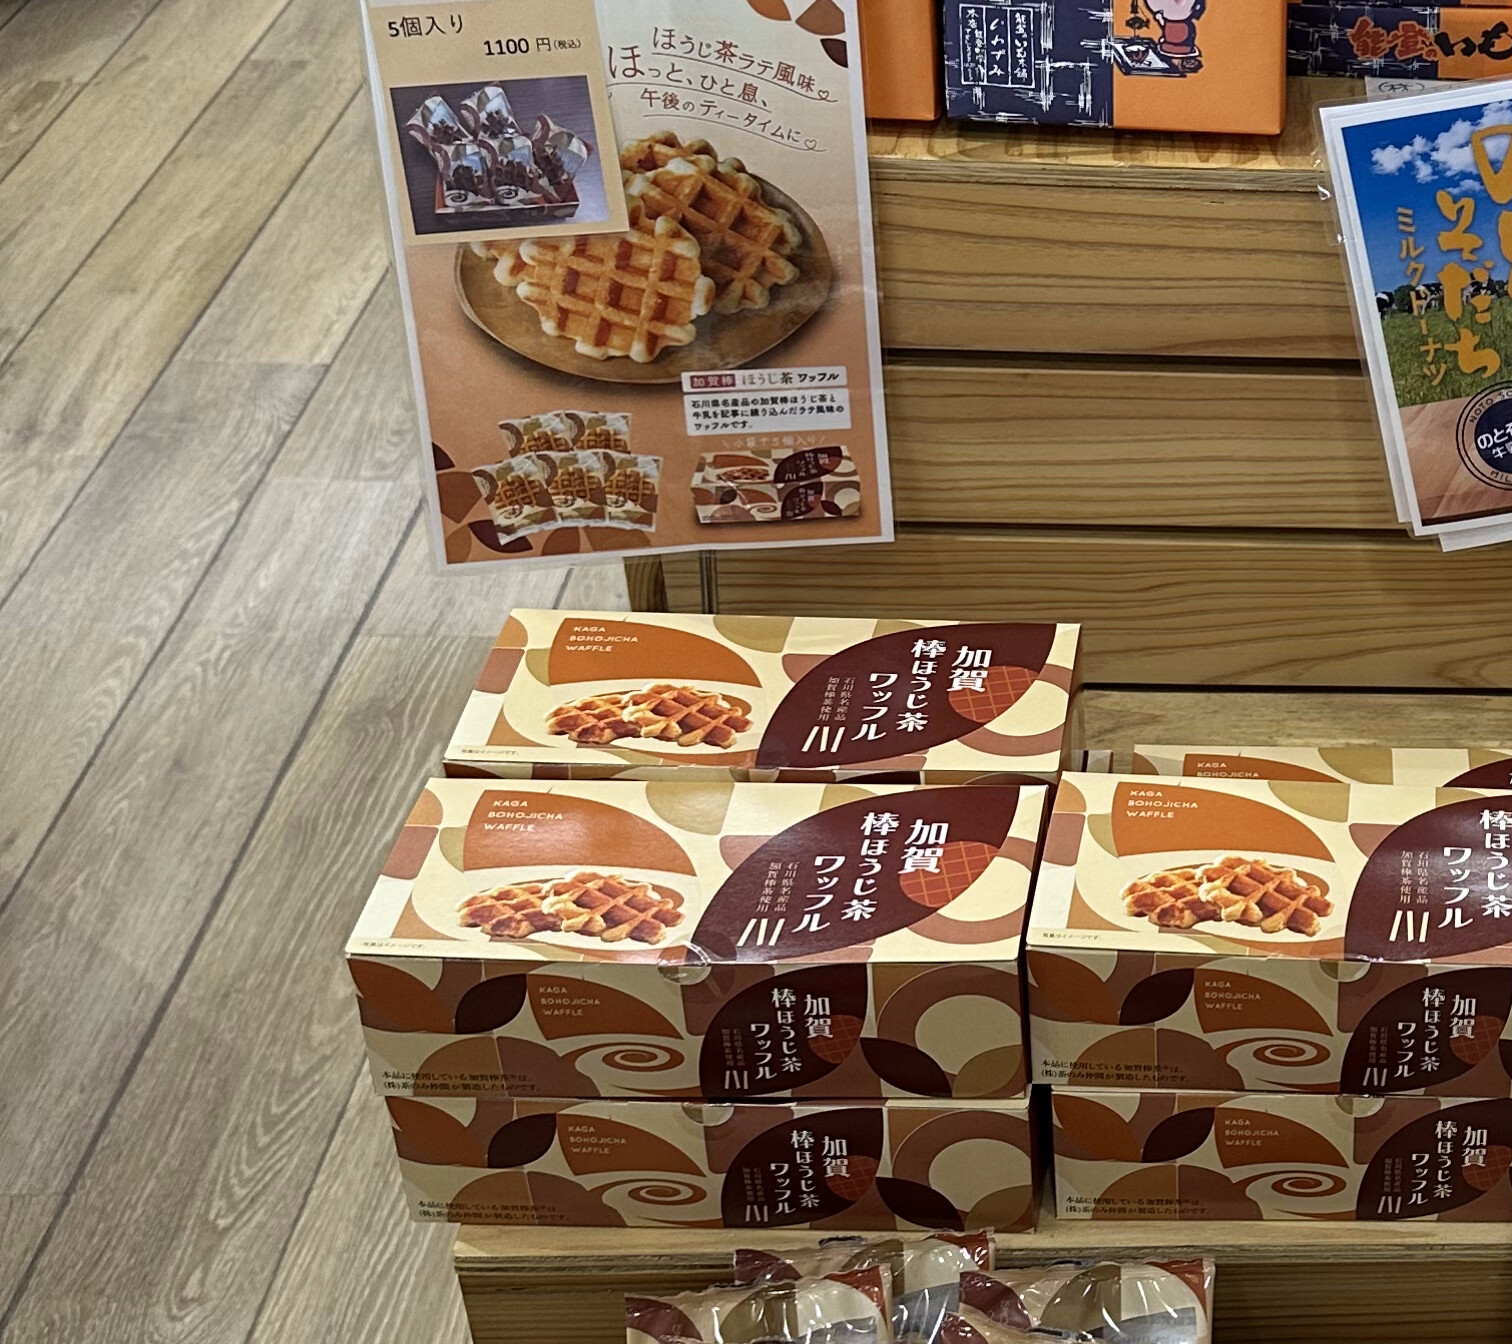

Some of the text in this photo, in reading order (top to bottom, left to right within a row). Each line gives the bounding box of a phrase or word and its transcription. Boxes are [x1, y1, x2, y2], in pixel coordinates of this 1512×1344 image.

[387, 14, 465, 39] 5個入り
[607, 43, 770, 108] ほっと、ひと息、
[652, 26, 817, 93] ほうじ茶ラテ風味
[640, 87, 802, 144] 午後のティータイムに
[1436, 189, 1501, 379] そだち
[691, 372, 794, 388] 加賀棒 ほうじ茶
[691, 394, 837, 409] 石川県名産品の加賀棒ほうじ茶と
[694, 420, 753, 431] ワッフルです。
[895, 638, 947, 732] 棒ほうじ茶
[947, 645, 992, 693] 加賀
[852, 672, 901, 741] ワッフル
[492, 798, 529, 808] KAGA
[1125, 810, 1175, 819] WAFFLE
[1129, 789, 1164, 798] KAGA
[484, 822, 536, 833] WAFFLE
[898, 818, 949, 876] 加賀
[841, 811, 901, 921] 棒ほうじ茶
[1437, 845, 1474, 930] ワッフル
[791, 856, 847, 934] ワッフル
[770, 987, 803, 1074] 棒ほうじ茶
[803, 992, 834, 1040] 加賀
[1421, 986, 1447, 1073] 棒ほうじ茶
[1448, 993, 1478, 1040] 加賀
[750, 1022, 779, 1081] ワッフル
[1394, 1021, 1418, 1079] ワッフル
[790, 1129, 821, 1209] 棒ほうじ茶
[822, 1135, 851, 1178] 加賀
[1434, 1118, 1459, 1200] 棒ほうじ茶
[1462, 1125, 1489, 1168] 加賀
[770, 1162, 798, 1217] ワッフル
[1408, 1152, 1431, 1205] ワッフル
